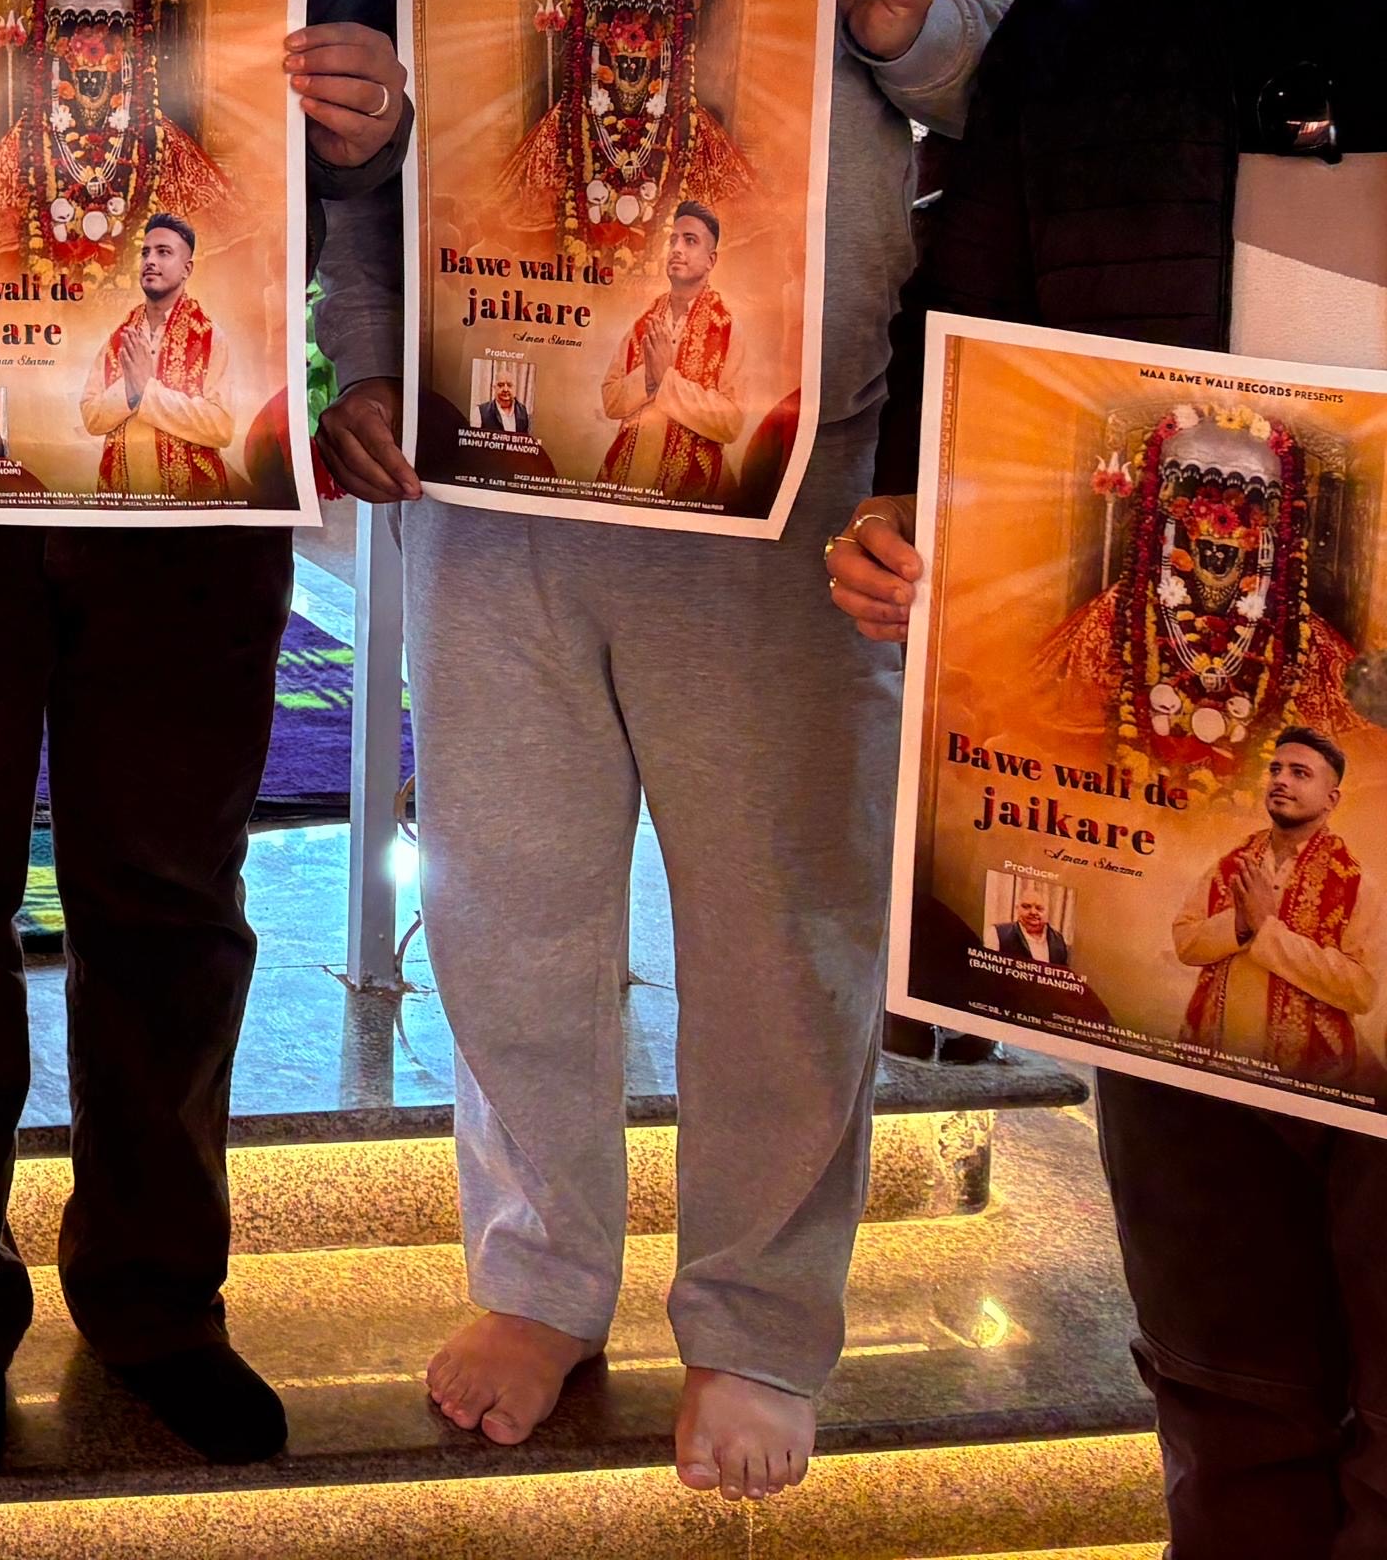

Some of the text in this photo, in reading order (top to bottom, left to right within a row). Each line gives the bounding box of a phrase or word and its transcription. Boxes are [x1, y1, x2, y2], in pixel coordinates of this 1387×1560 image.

[439, 247, 614, 286] Bawe wali de
[50, 273, 84, 302] de
[462, 288, 591, 328] jaikare
[485, 348, 525, 358] Producer
[1139, 368, 1344, 403] MAA BAWE WALI RECORDS PRESENTS
[458, 429, 491, 439] MAHANT
[492, 432, 510, 441] SHRI
[511, 435, 533, 445] BITTA
[484, 440, 505, 450] FORT
[506, 443, 540, 455] MANDIR)
[947, 731, 1189, 811] Bawe wali de
[973, 786, 1156, 856] jaikare
[1003, 859, 1060, 880] Producer
[967, 947, 1088, 984] MAHANT SHRI BITTA JI
[969, 958, 1085, 995] (BAHU FORT MANDIR)
